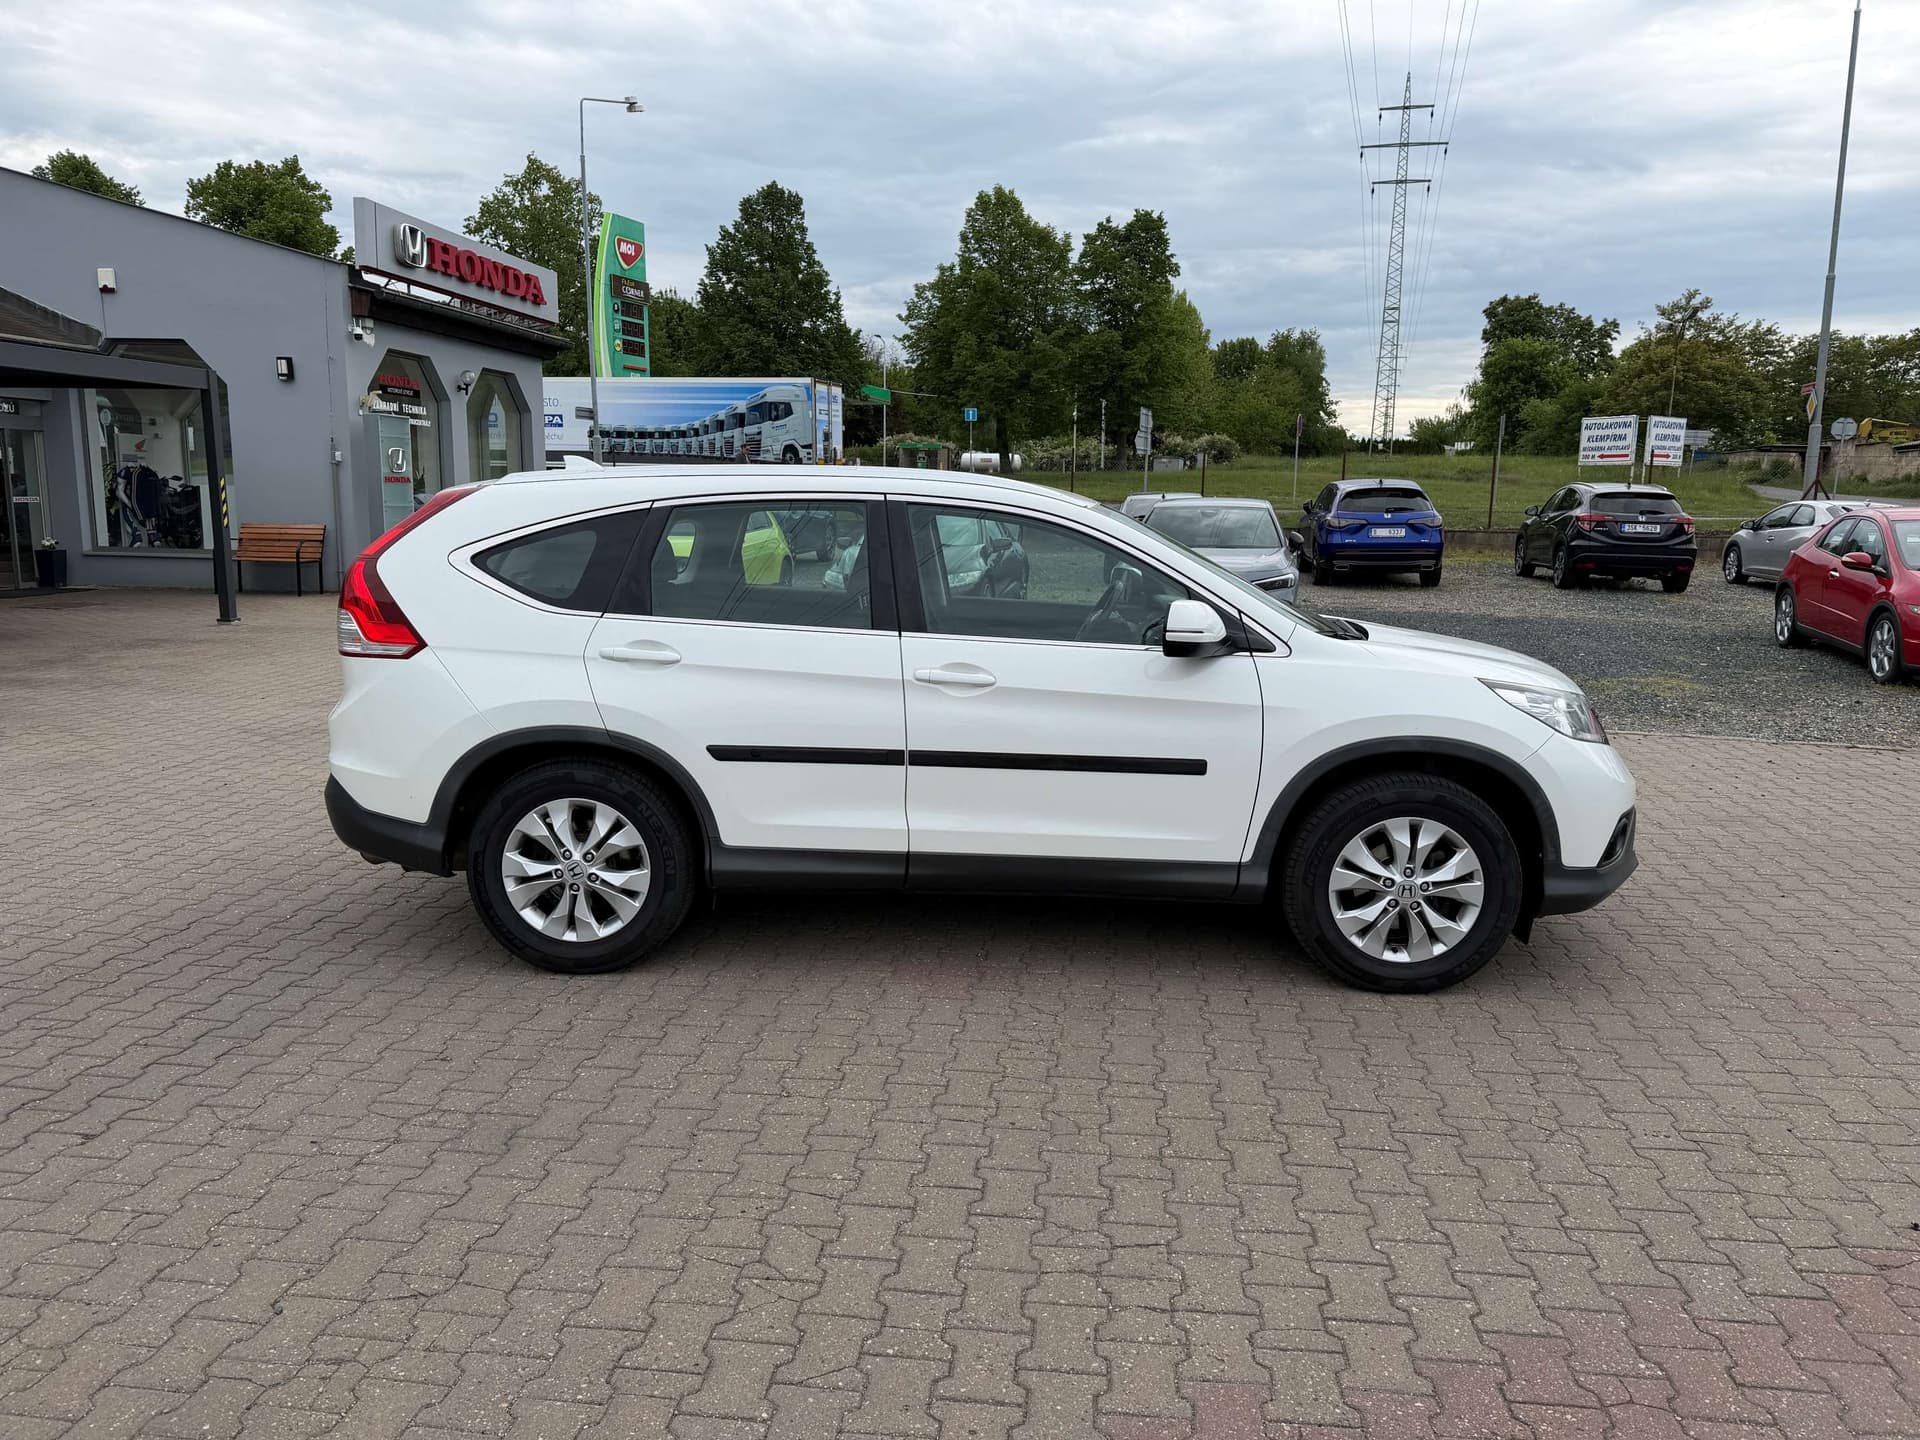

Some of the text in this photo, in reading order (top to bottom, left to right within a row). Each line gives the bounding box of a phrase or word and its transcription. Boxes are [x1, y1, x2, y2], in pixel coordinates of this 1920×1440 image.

[619, 241, 635, 256] MOL
[427, 237, 547, 305] HONDA
[379, 374, 419, 388] HONDA
[403, 404, 426, 415] TECHNIKA
[544, 415, 562, 424] PA
[1653, 420, 1684, 430] AUTOLAKOVNA
[1584, 420, 1632, 431] AUTOLAKOVNA
[1586, 431, 1627, 443] KLEMPÍRNA
[1654, 432, 1681, 442] KLEMPÍRNA
[384, 476, 411, 484] HONDA
